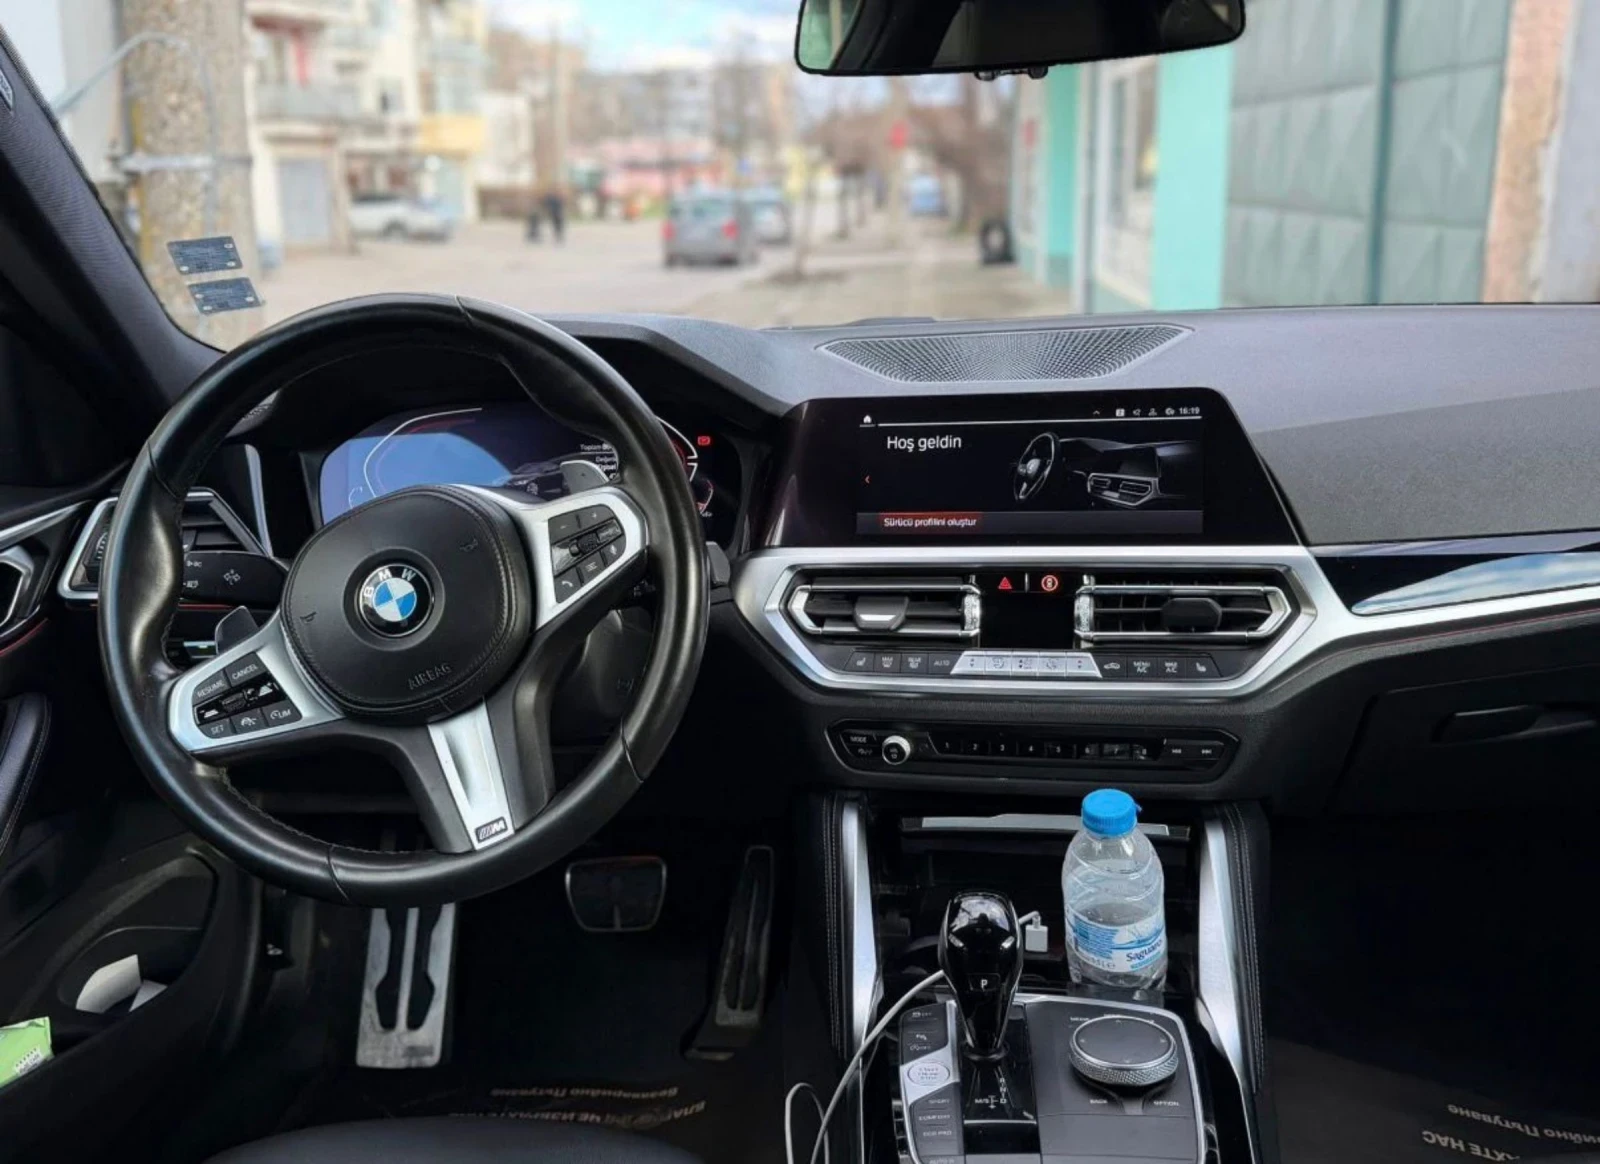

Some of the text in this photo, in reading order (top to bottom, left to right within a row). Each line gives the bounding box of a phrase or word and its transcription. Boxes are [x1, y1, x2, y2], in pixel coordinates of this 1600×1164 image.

[1178, 406, 1201, 415] 16:19
[886, 435, 963, 453] Hoş geldin
[883, 516, 978, 529] Sürücü profilini oluştur
[362, 567, 417, 599] BMW
[231, 662, 259, 680] CANCEL
[933, 659, 951, 667] AUTO
[407, 661, 453, 691] AIRBAG
[196, 679, 226, 699] RESUME
[278, 708, 292, 719] LIM
[210, 724, 225, 735] SET
[979, 977, 989, 991] P
[1153, 1099, 1181, 1107] OPTION
[1447, 1103, 1540, 1138] Пътуване
[1422, 1129, 1466, 1153] НАС
